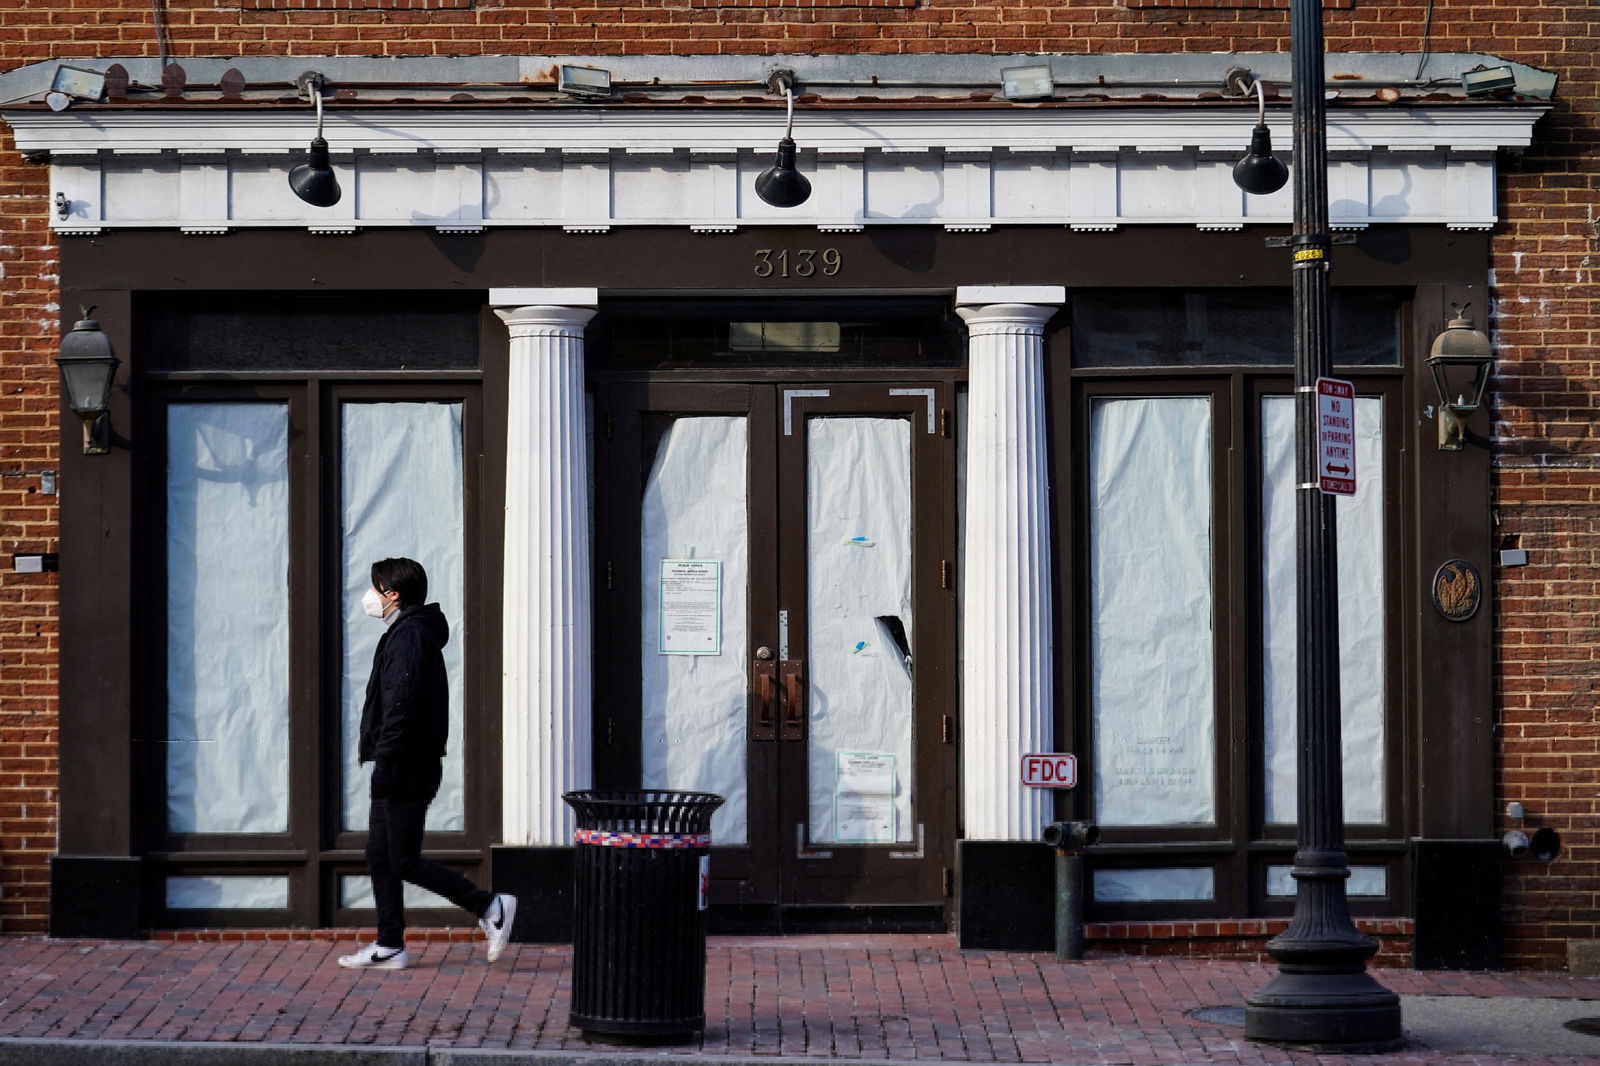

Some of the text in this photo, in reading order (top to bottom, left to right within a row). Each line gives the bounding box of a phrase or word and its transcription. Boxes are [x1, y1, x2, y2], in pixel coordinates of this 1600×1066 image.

[754, 247, 842, 277] 3139
[1331, 399, 1341, 413] NO
[1323, 414, 1349, 429] STANDING
[1328, 430, 1351, 445] PARKING
[1326, 445, 1350, 459] ANYTIME
[1028, 759, 1067, 782] FDC
